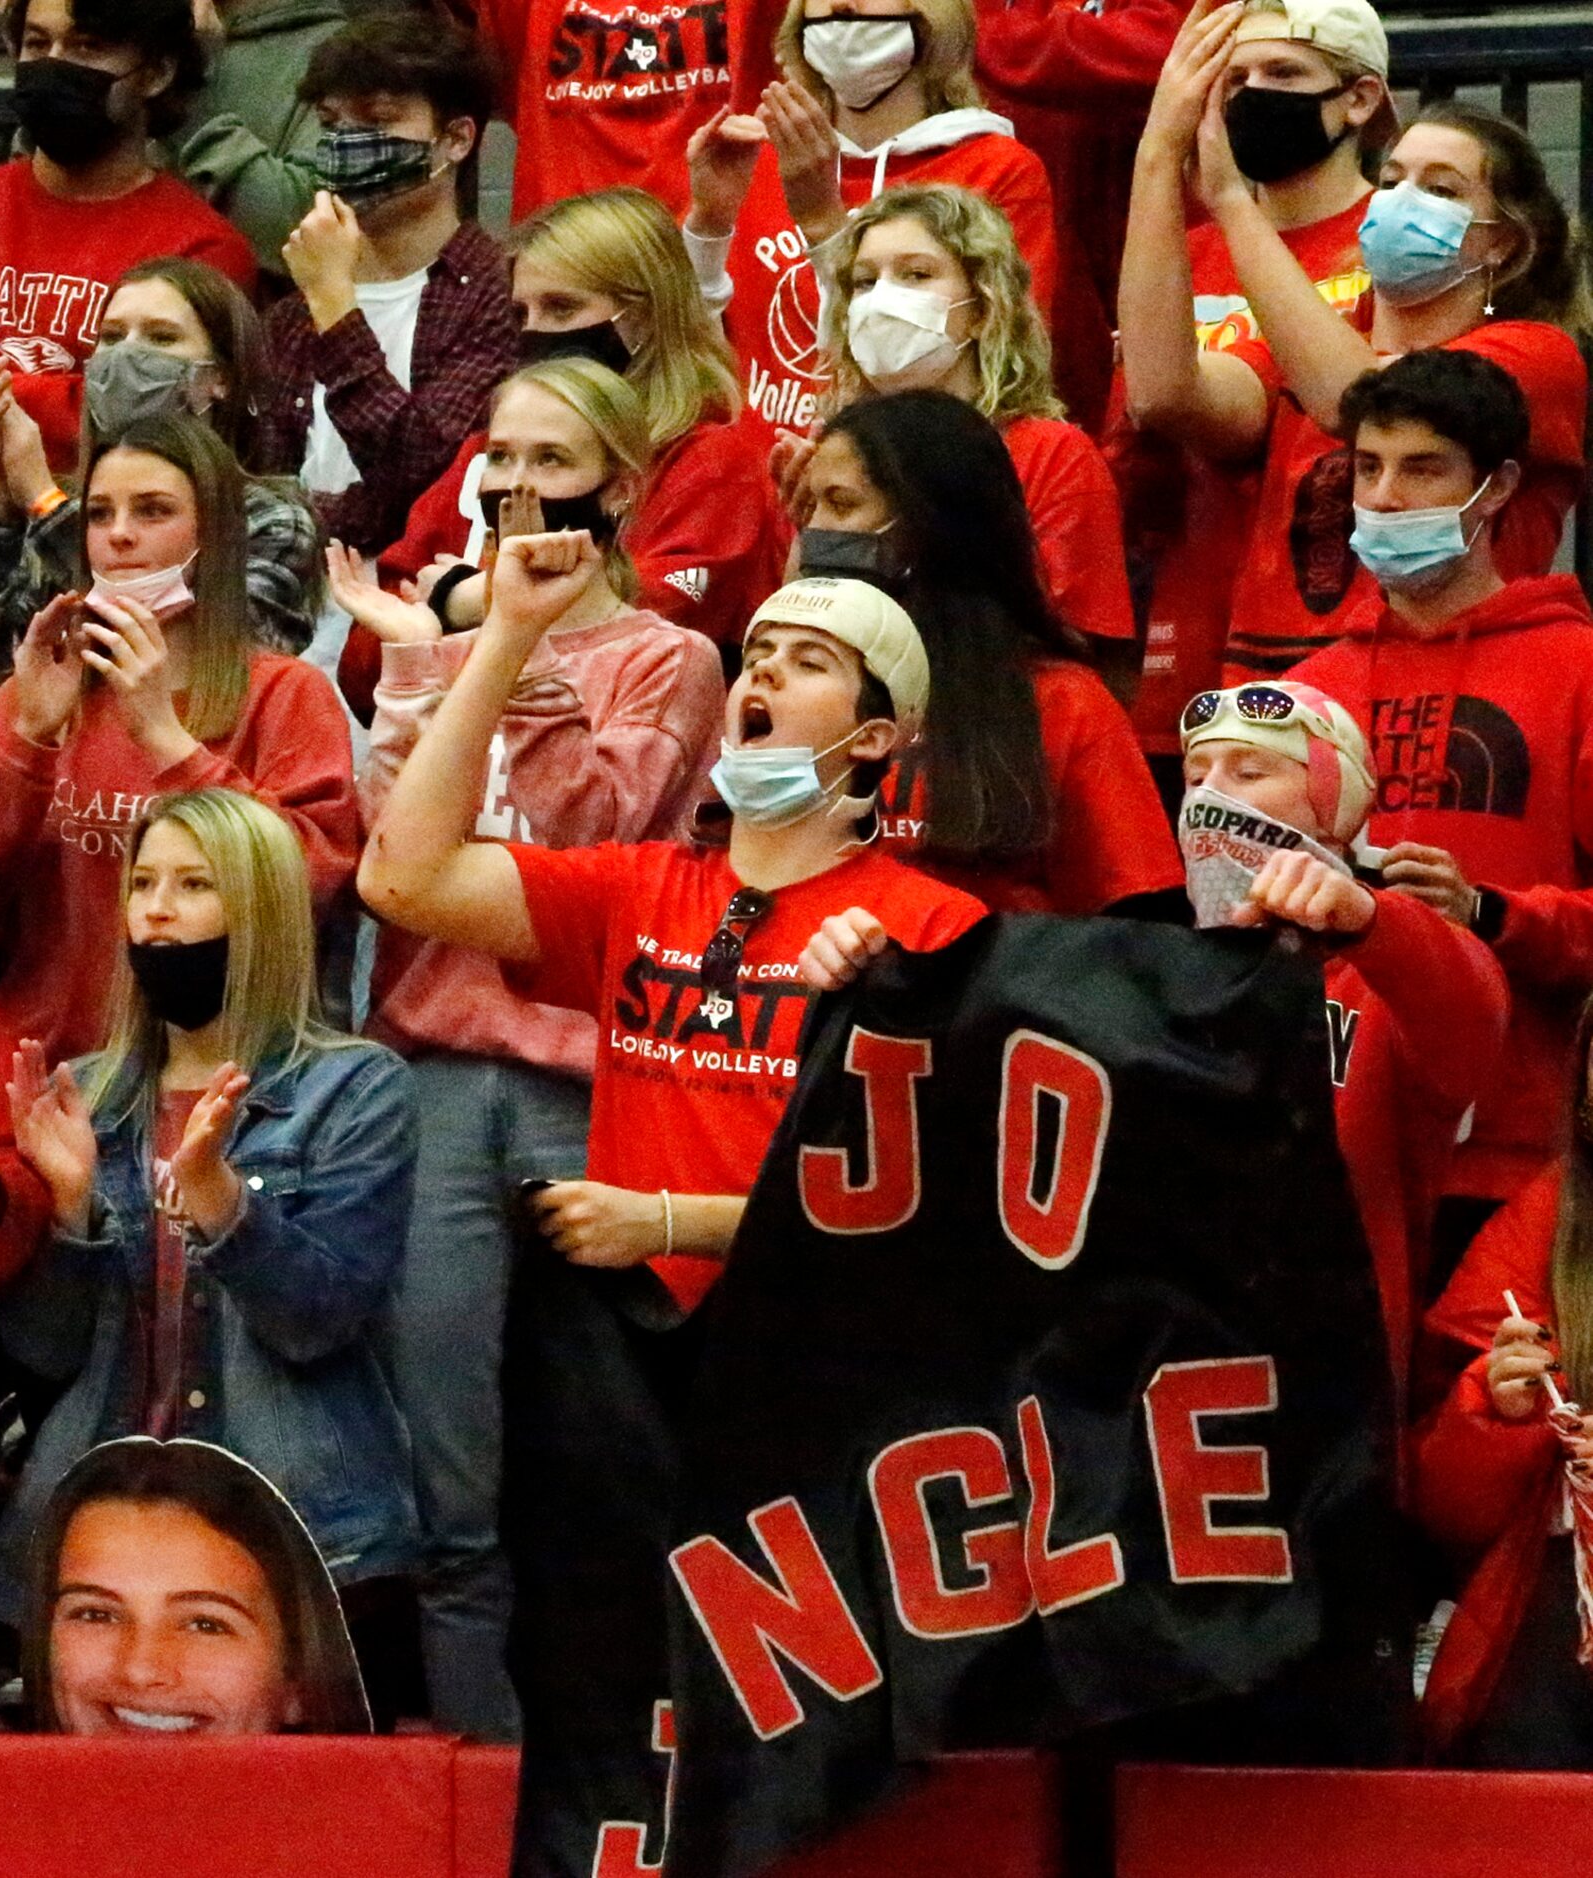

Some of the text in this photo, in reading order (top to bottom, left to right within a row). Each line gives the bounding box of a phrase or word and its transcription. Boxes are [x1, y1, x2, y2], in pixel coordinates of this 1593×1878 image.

[623, 67, 731, 98] VOLLEYBA
[748, 357, 817, 427] Volle
[692, 1049, 798, 1077] VOLLEYB
